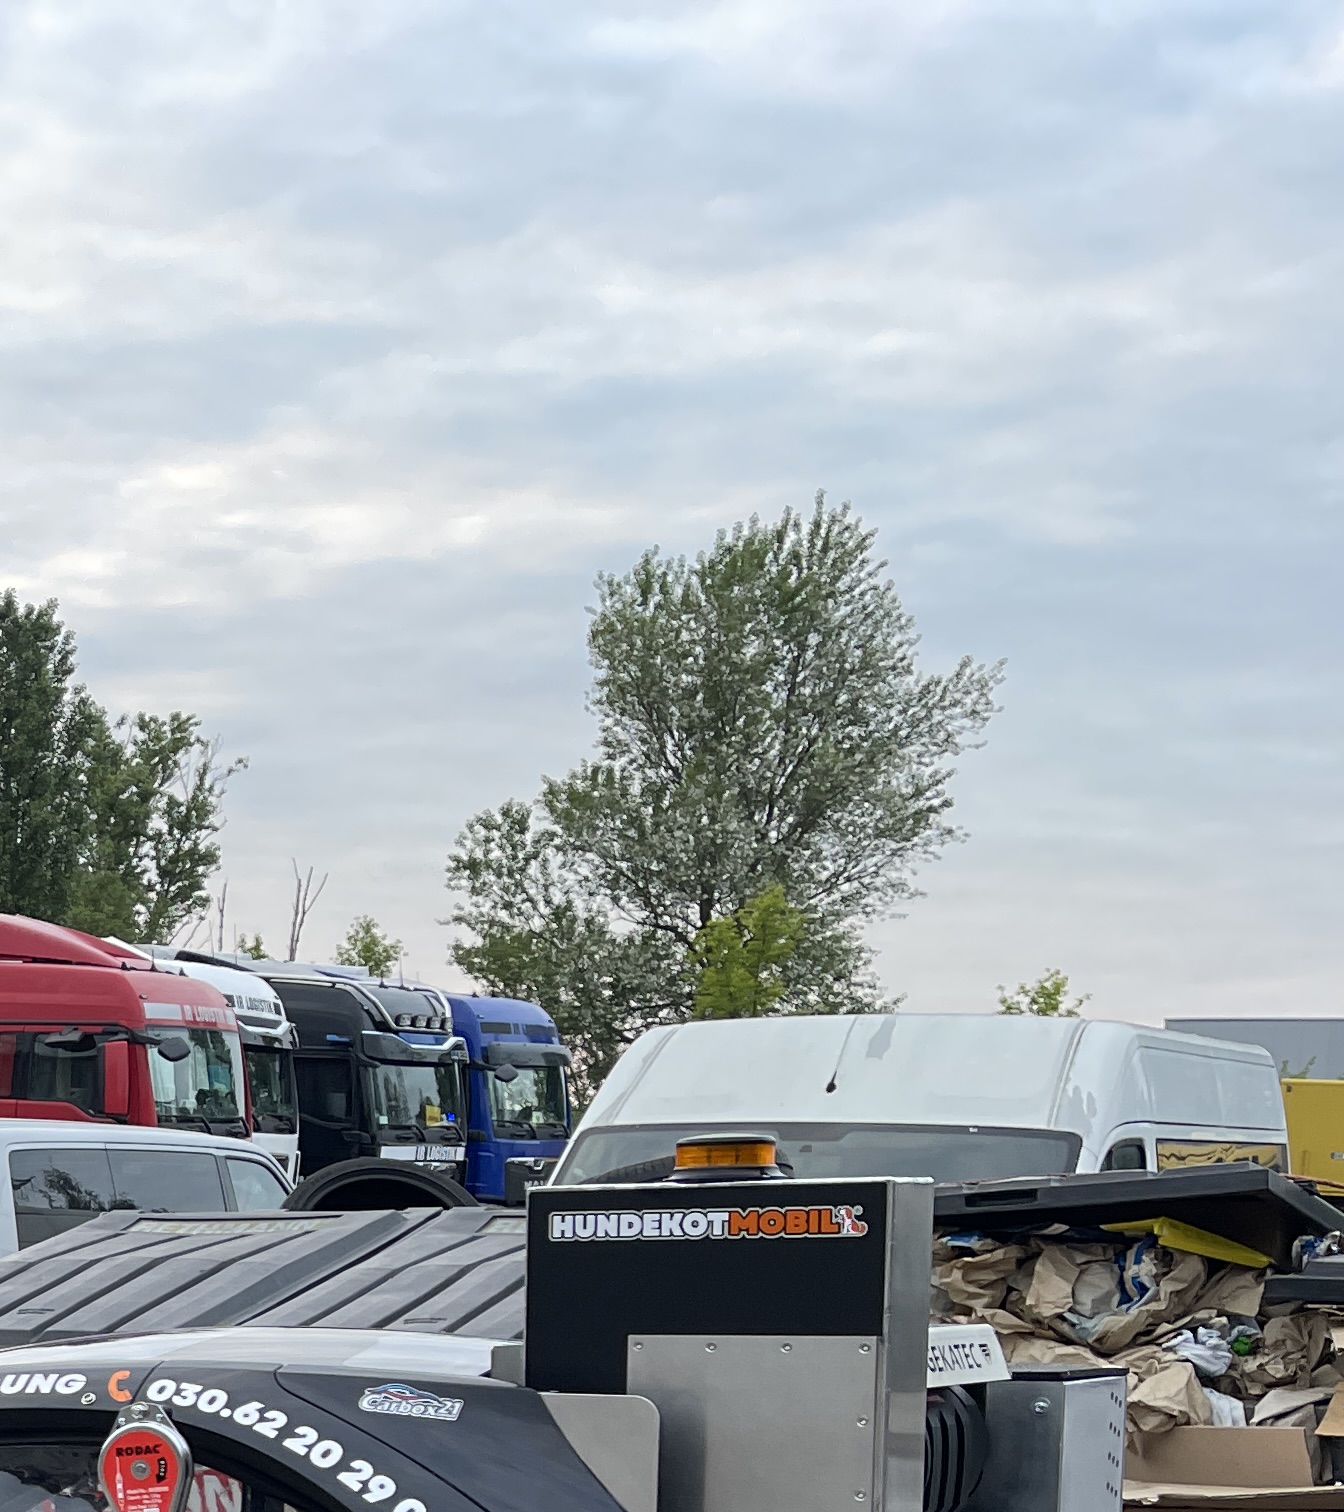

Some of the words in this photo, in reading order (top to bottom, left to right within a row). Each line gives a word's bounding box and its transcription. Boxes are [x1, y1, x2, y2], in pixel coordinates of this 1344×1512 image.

[550, 1208, 840, 1240] HUNDEKOTMOBIL
[360, 1394, 464, 1420] Carbox21
[115, 1443, 163, 1457] RODAC
[146, 1378, 288, 1440] 030.62
[282, 1425, 344, 1469] 20
[336, 1459, 397, 1504] 29
